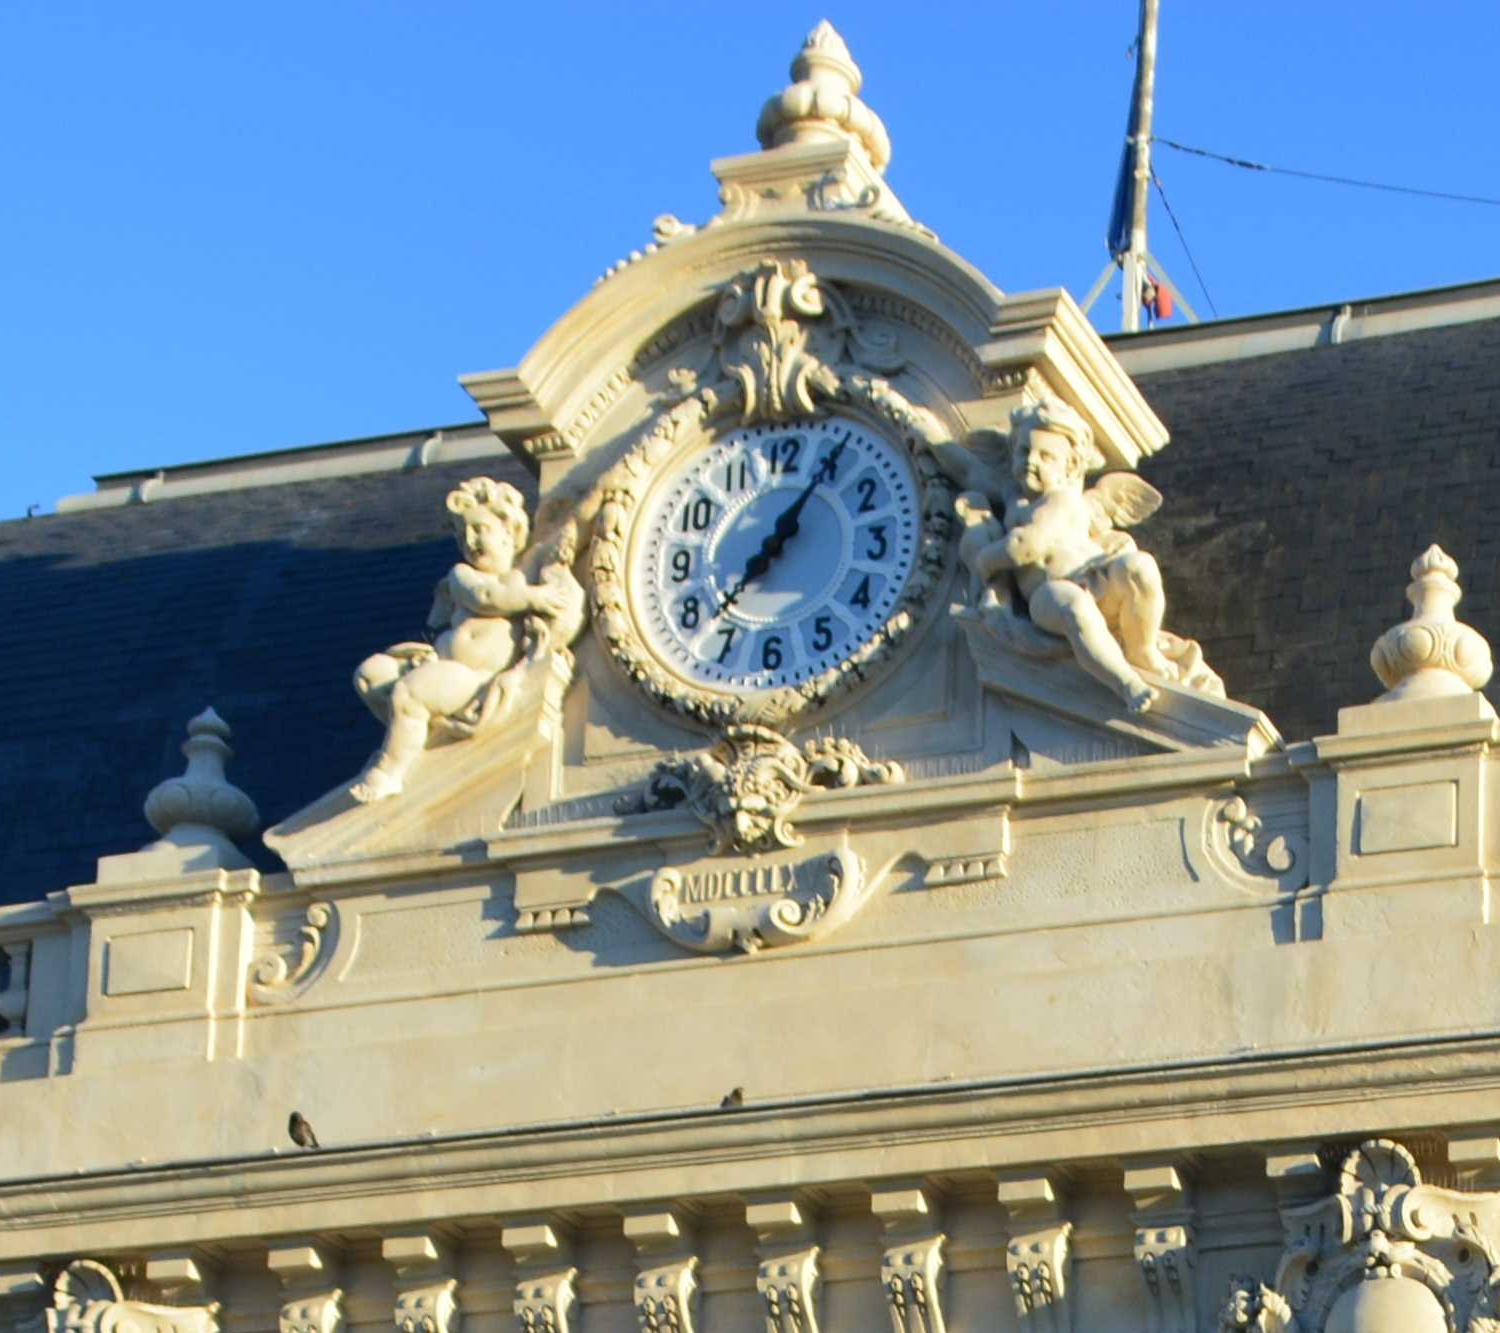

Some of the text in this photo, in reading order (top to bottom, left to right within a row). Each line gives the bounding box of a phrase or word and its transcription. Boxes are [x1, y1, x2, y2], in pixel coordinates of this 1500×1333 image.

[770, 438, 800, 474] 12
[726, 461, 745, 492] 11
[857, 478, 877, 512] 2
[681, 499, 711, 532] 10
[866, 525, 887, 560] 3
[671, 550, 690, 582] 9
[852, 575, 870, 609] 4
[681, 596, 699, 629] 8
[717, 628, 736, 664] 7
[812, 617, 832, 650] 5
[762, 636, 782, 670] 6
